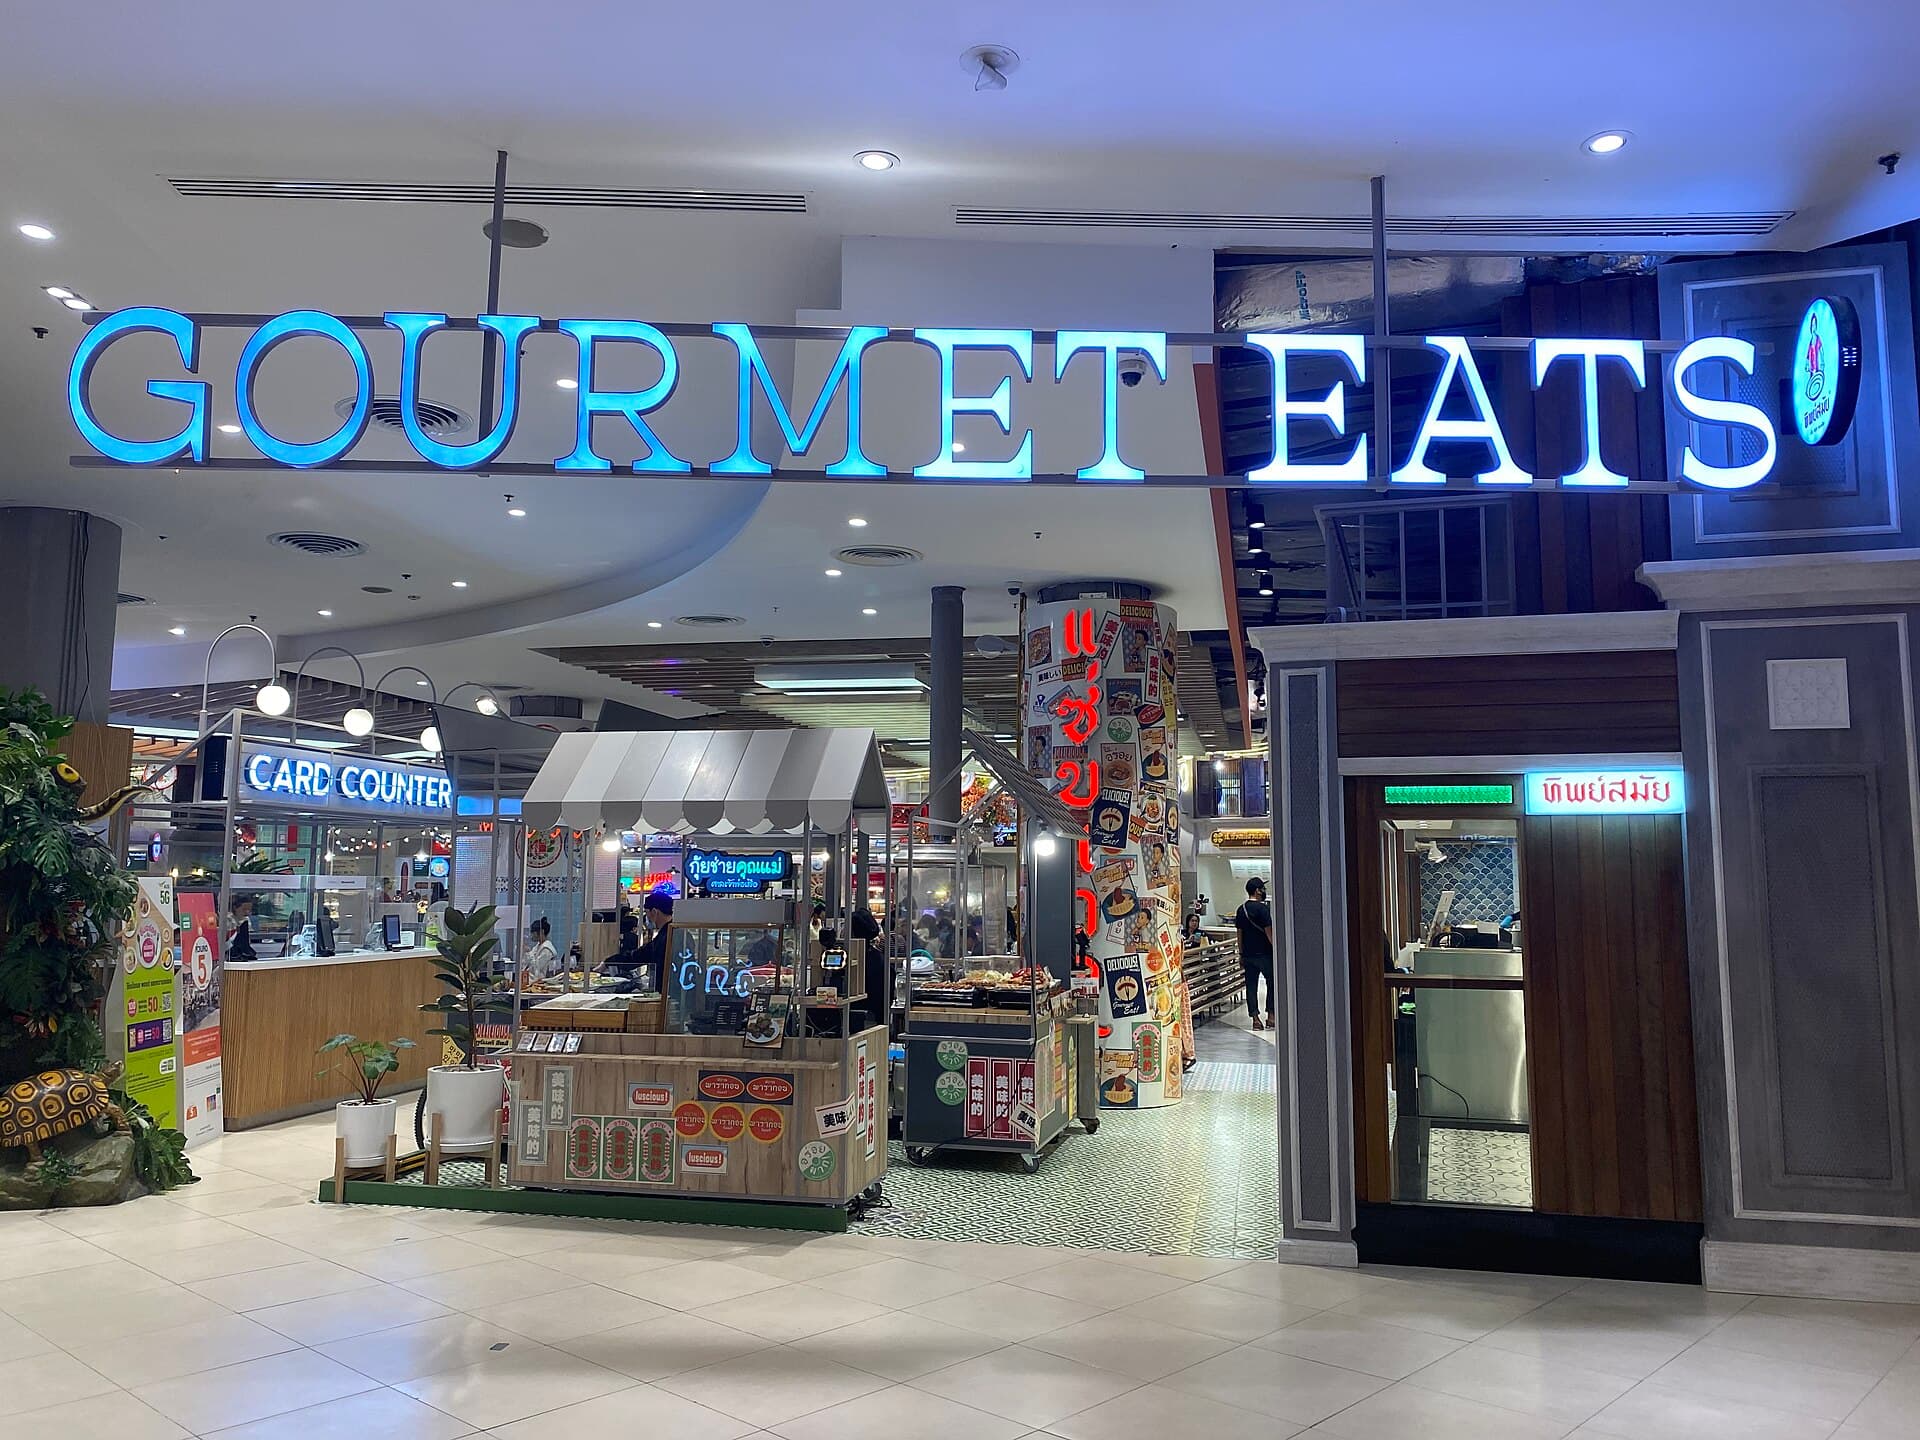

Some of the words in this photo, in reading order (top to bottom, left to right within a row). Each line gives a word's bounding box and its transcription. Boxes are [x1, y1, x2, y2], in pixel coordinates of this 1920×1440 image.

[67, 305, 1168, 482] GOURMET
[1244, 333, 1778, 489] EATS
[245, 754, 331, 797] CARD
[338, 766, 453, 809] COUNTER
[1543, 774, 1670, 802] ทิพย์สมัย
[160, 890, 170, 905] 5G
[198, 954, 207, 984] 5
[1107, 955, 1139, 972] DELICIOUS!
[147, 995, 158, 1013] 50
[551, 1071, 565, 1120] 美味的
[635, 1090, 668, 1102] luscious!
[970, 1074, 984, 1116] 美味的
[995, 1075, 1009, 1117] 美味的
[1020, 1076, 1034, 1104] 美味
[526, 1107, 541, 1155] 美味的
[688, 1151, 722, 1164] luscious!
